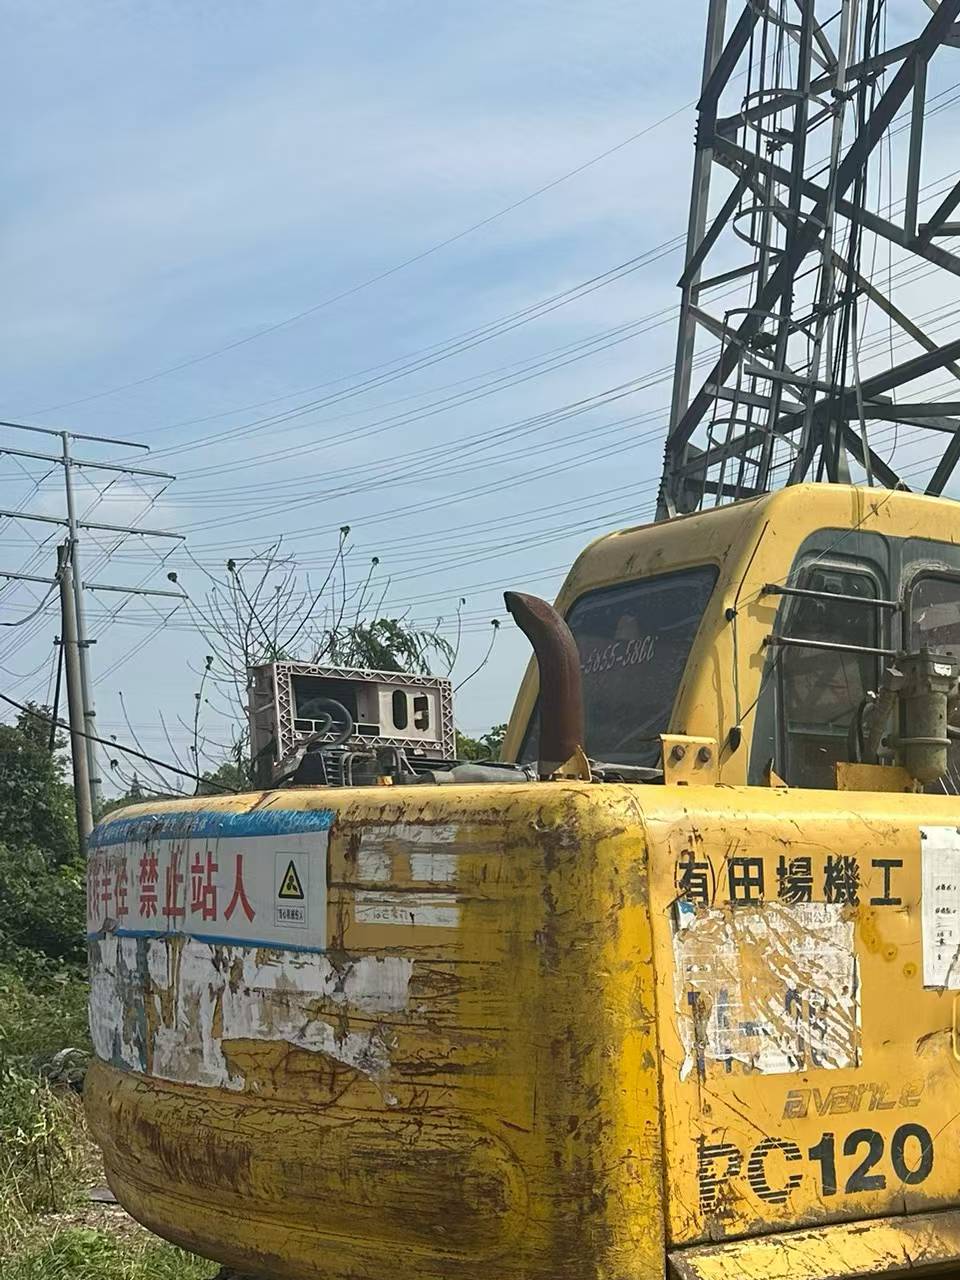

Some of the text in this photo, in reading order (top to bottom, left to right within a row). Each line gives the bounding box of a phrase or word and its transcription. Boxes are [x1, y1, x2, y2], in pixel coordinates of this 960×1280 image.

[139, 850, 256, 923] 禁止站人
[697, 1122, 935, 1213] PC120
